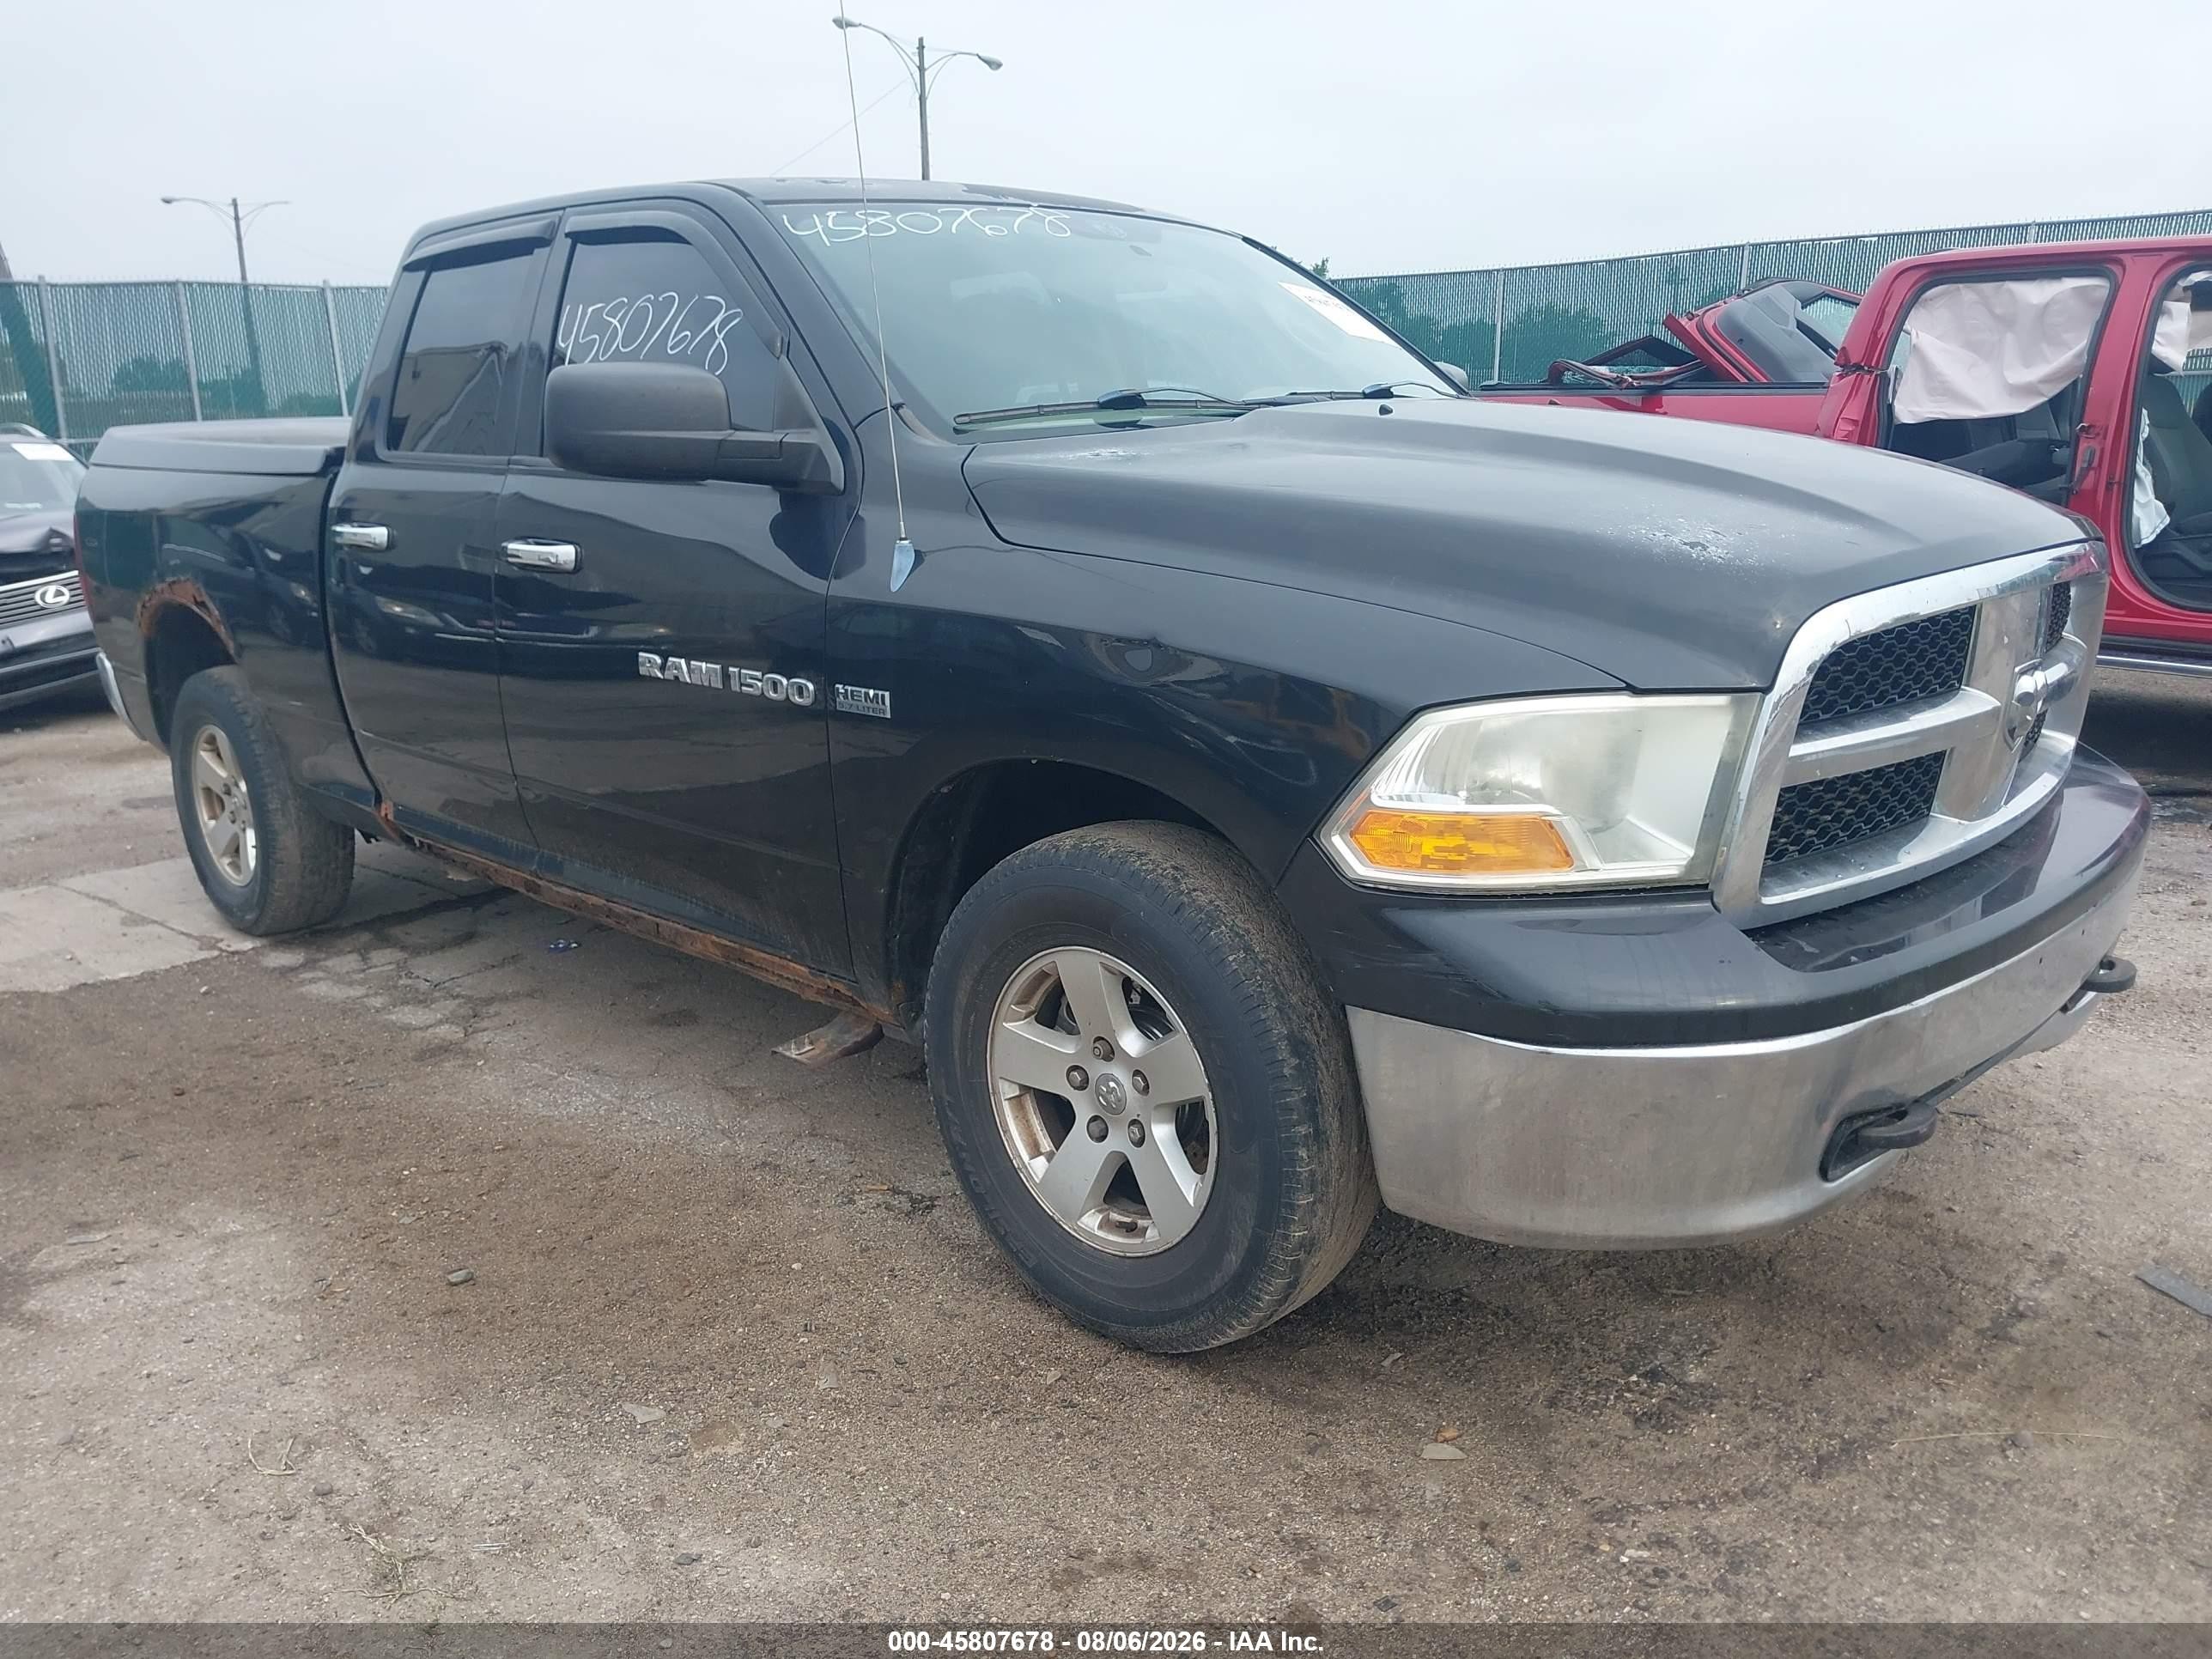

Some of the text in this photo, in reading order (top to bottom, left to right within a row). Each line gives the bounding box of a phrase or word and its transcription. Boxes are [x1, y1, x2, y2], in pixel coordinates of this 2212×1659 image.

[782, 207, 1072, 246] 45807678
[558, 291, 744, 376] 45807678
[638, 651, 815, 707] RAM 1500
[835, 684, 890, 707] HEMI
